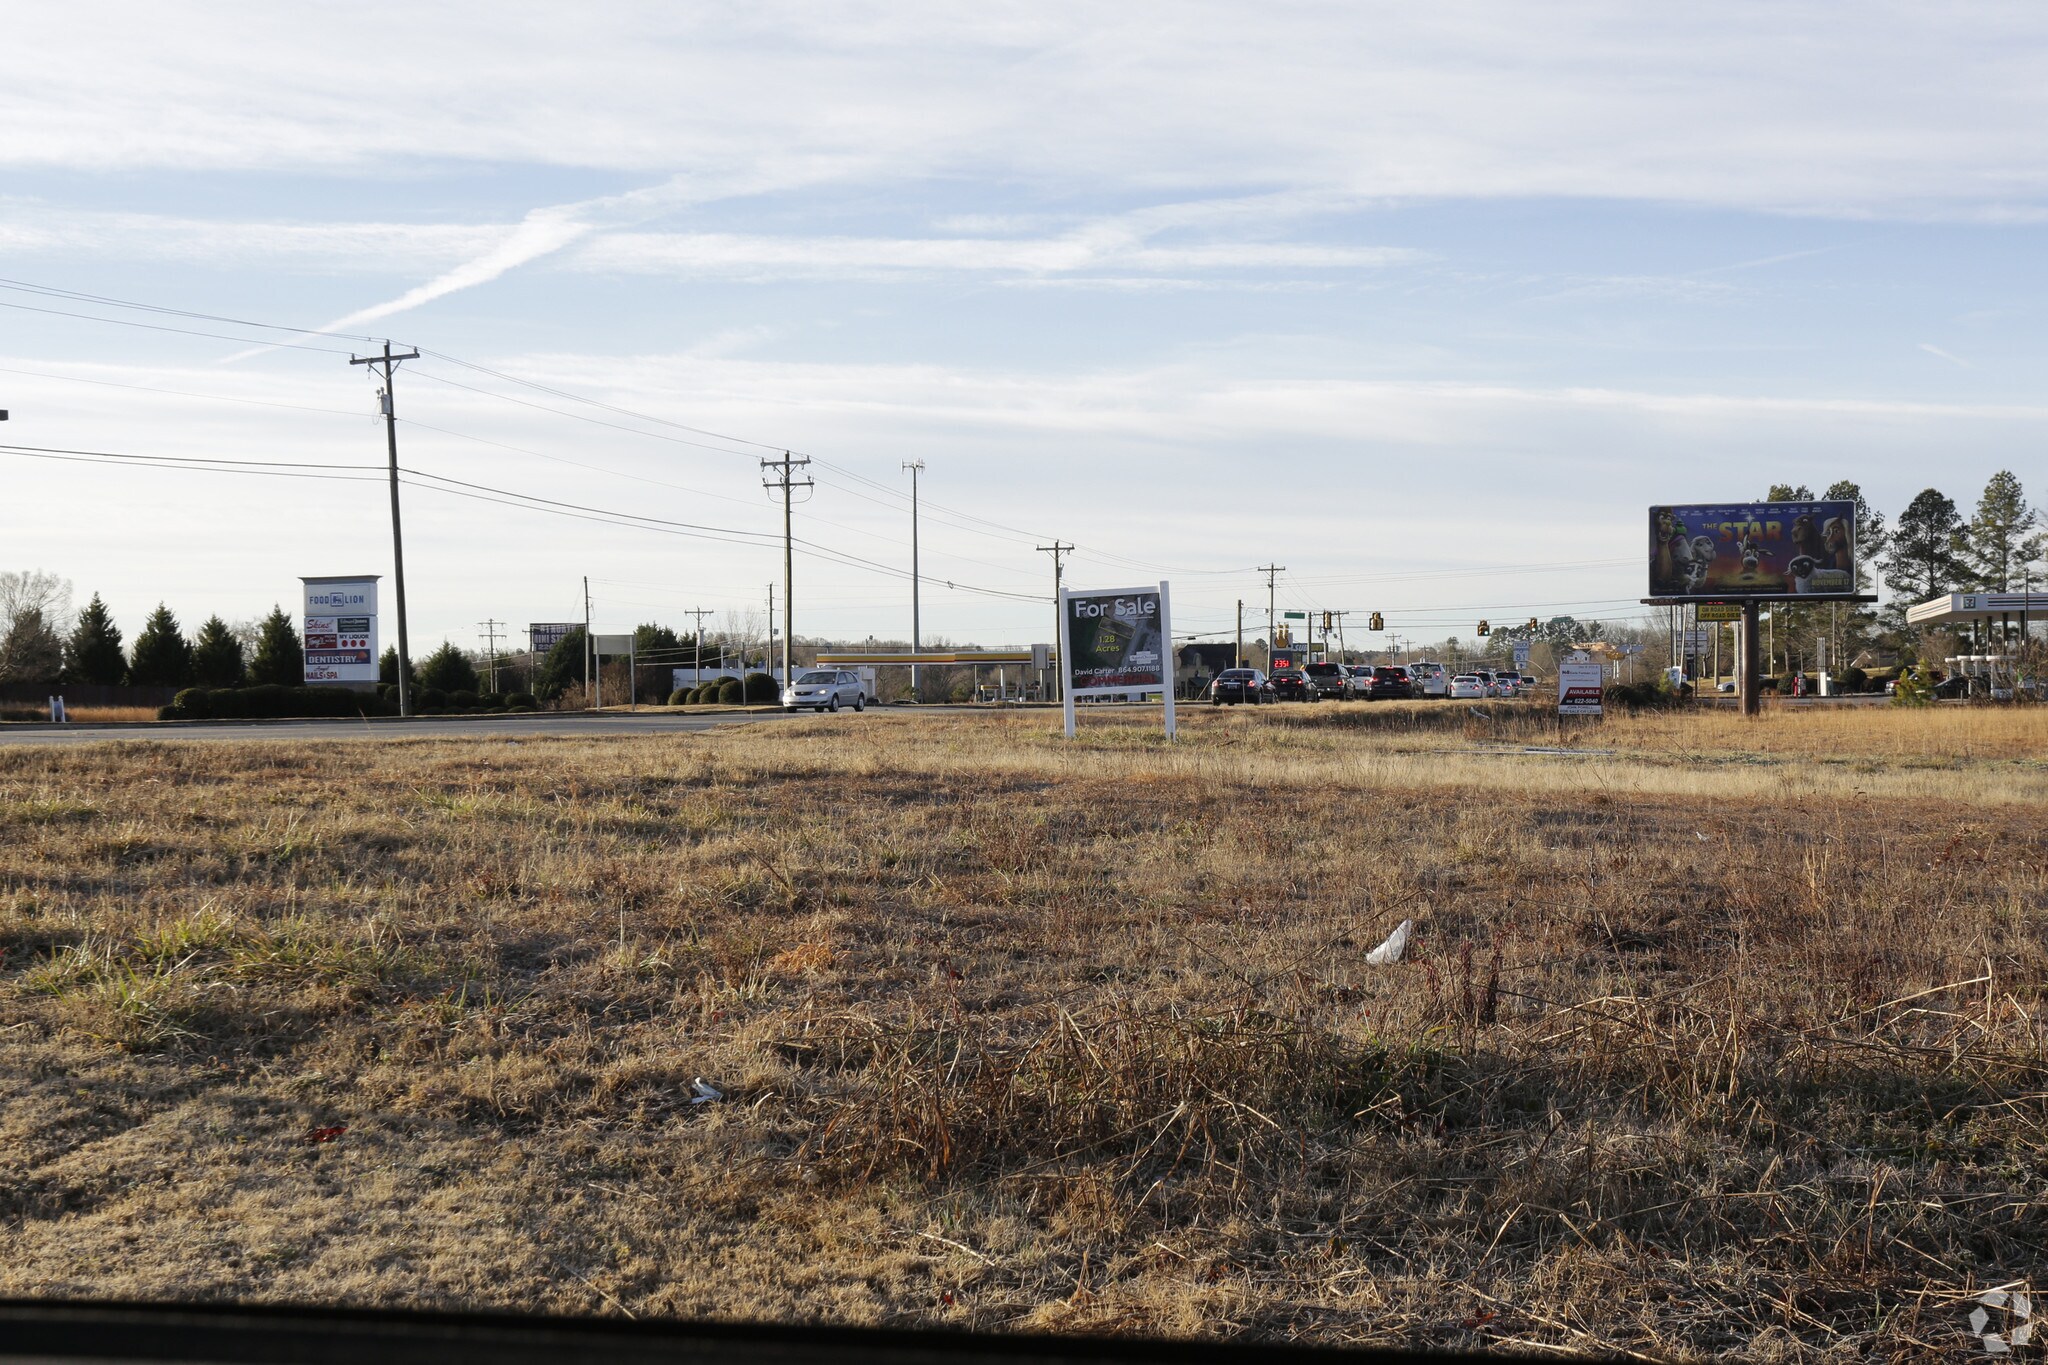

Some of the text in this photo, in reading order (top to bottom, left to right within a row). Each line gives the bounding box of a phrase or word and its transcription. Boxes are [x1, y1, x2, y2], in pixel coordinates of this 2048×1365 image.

[1718, 521, 1782, 543] STAR
[309, 595, 364, 604] FOOD LION
[1074, 596, 1156, 618] For Sale
[1099, 635, 1116, 643] 1.28
[1096, 645, 1120, 653] Acres
[308, 655, 357, 664] DENTISTRY
[1074, 668, 1093, 676] David
[1118, 664, 1160, 674] 864.907.1188
[327, 671, 338, 679] SPA
[1081, 674, 1156, 686] COMMERCIAL
